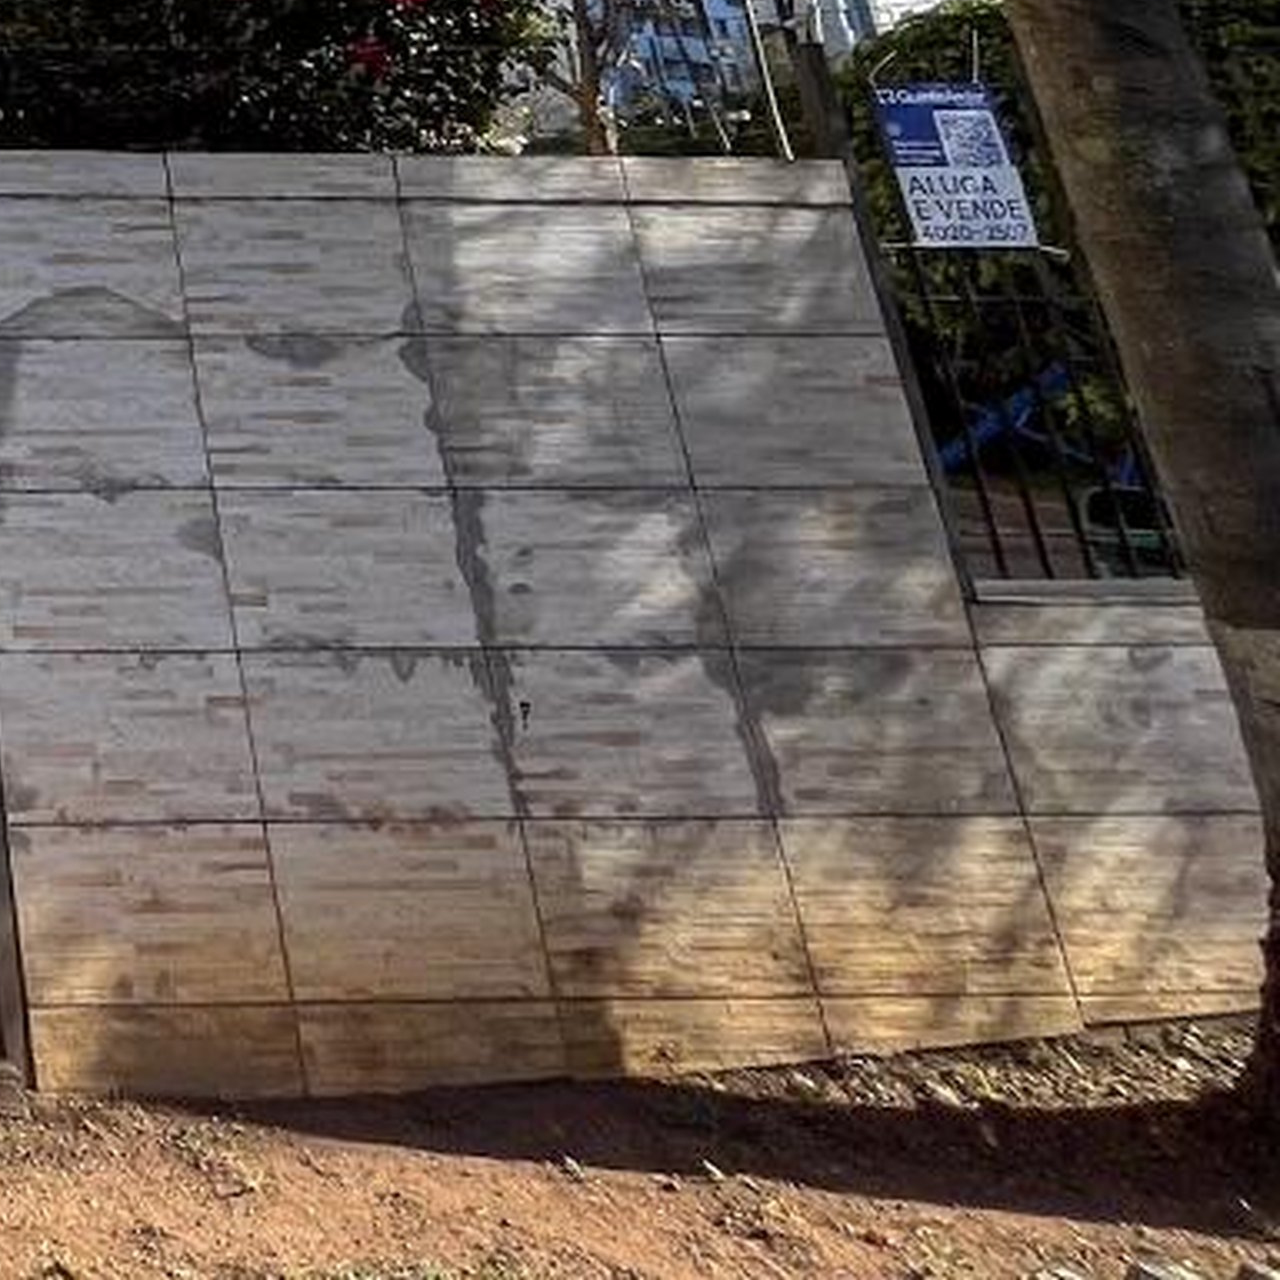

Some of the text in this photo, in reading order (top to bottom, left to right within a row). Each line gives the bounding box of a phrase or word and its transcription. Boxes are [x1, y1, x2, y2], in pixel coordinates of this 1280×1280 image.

[909, 175, 998, 195] ALUGA
[912, 199, 1026, 221] E VENDE
